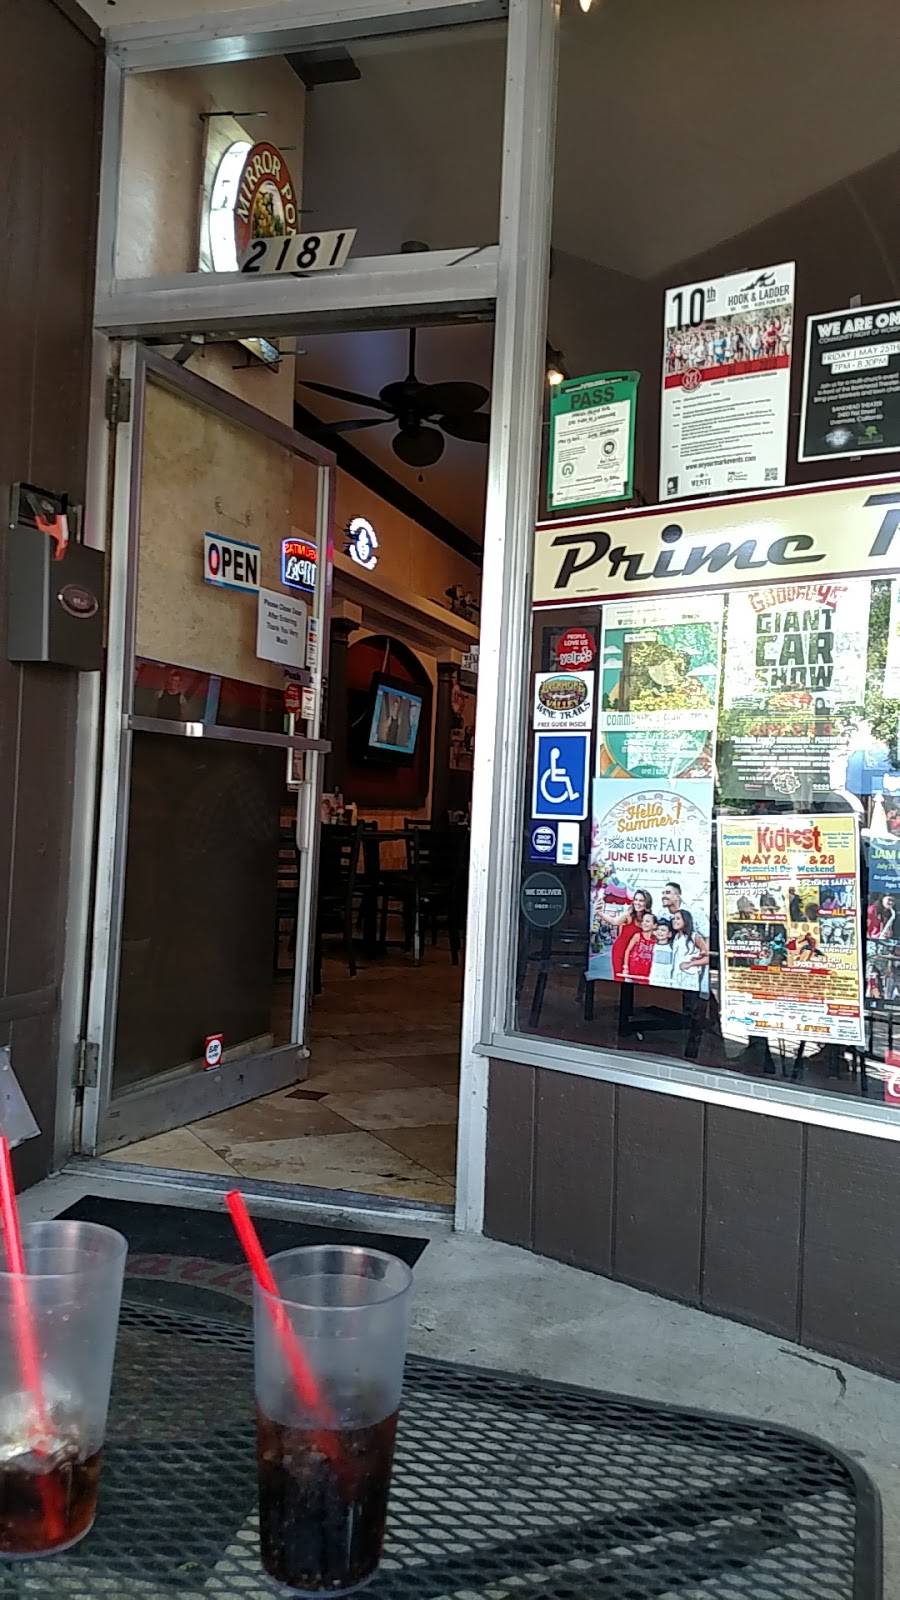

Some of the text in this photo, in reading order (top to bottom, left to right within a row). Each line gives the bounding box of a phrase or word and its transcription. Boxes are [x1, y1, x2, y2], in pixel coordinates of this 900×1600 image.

[238, 151, 297, 236] MIRROR PO
[241, 232, 346, 273] 2181
[728, 284, 790, 308] HOOK & LADDER
[817, 322, 841, 338] WE
[843, 316, 874, 334] ARE
[823, 351, 851, 362] FRIDAY
[858, 347, 877, 358] MAY
[833, 362, 850, 371] 7PM
[571, 386, 616, 410] PASS
[208, 542, 258, 585] OPEN
[551, 524, 827, 589] Prime
[756, 608, 837, 634] GIANT
[560, 652, 582, 666] yelp
[755, 632, 835, 667] CAR
[755, 665, 834, 688] SHOW
[536, 700, 592, 720] WINE TRAILS
[625, 801, 664, 821] Hello
[626, 836, 658, 845] ALAMEDA
[626, 843, 658, 851] COUNTY
[659, 838, 694, 853] FAIR
[604, 851, 635, 863] JUNE
[688, 855, 696, 866] 8
[740, 854, 772, 865] MAY
[809, 855, 818, 865] &
[819, 854, 836, 865] 28
[796, 864, 836, 873] Weekend
[536, 888, 562, 896] DELIVER
